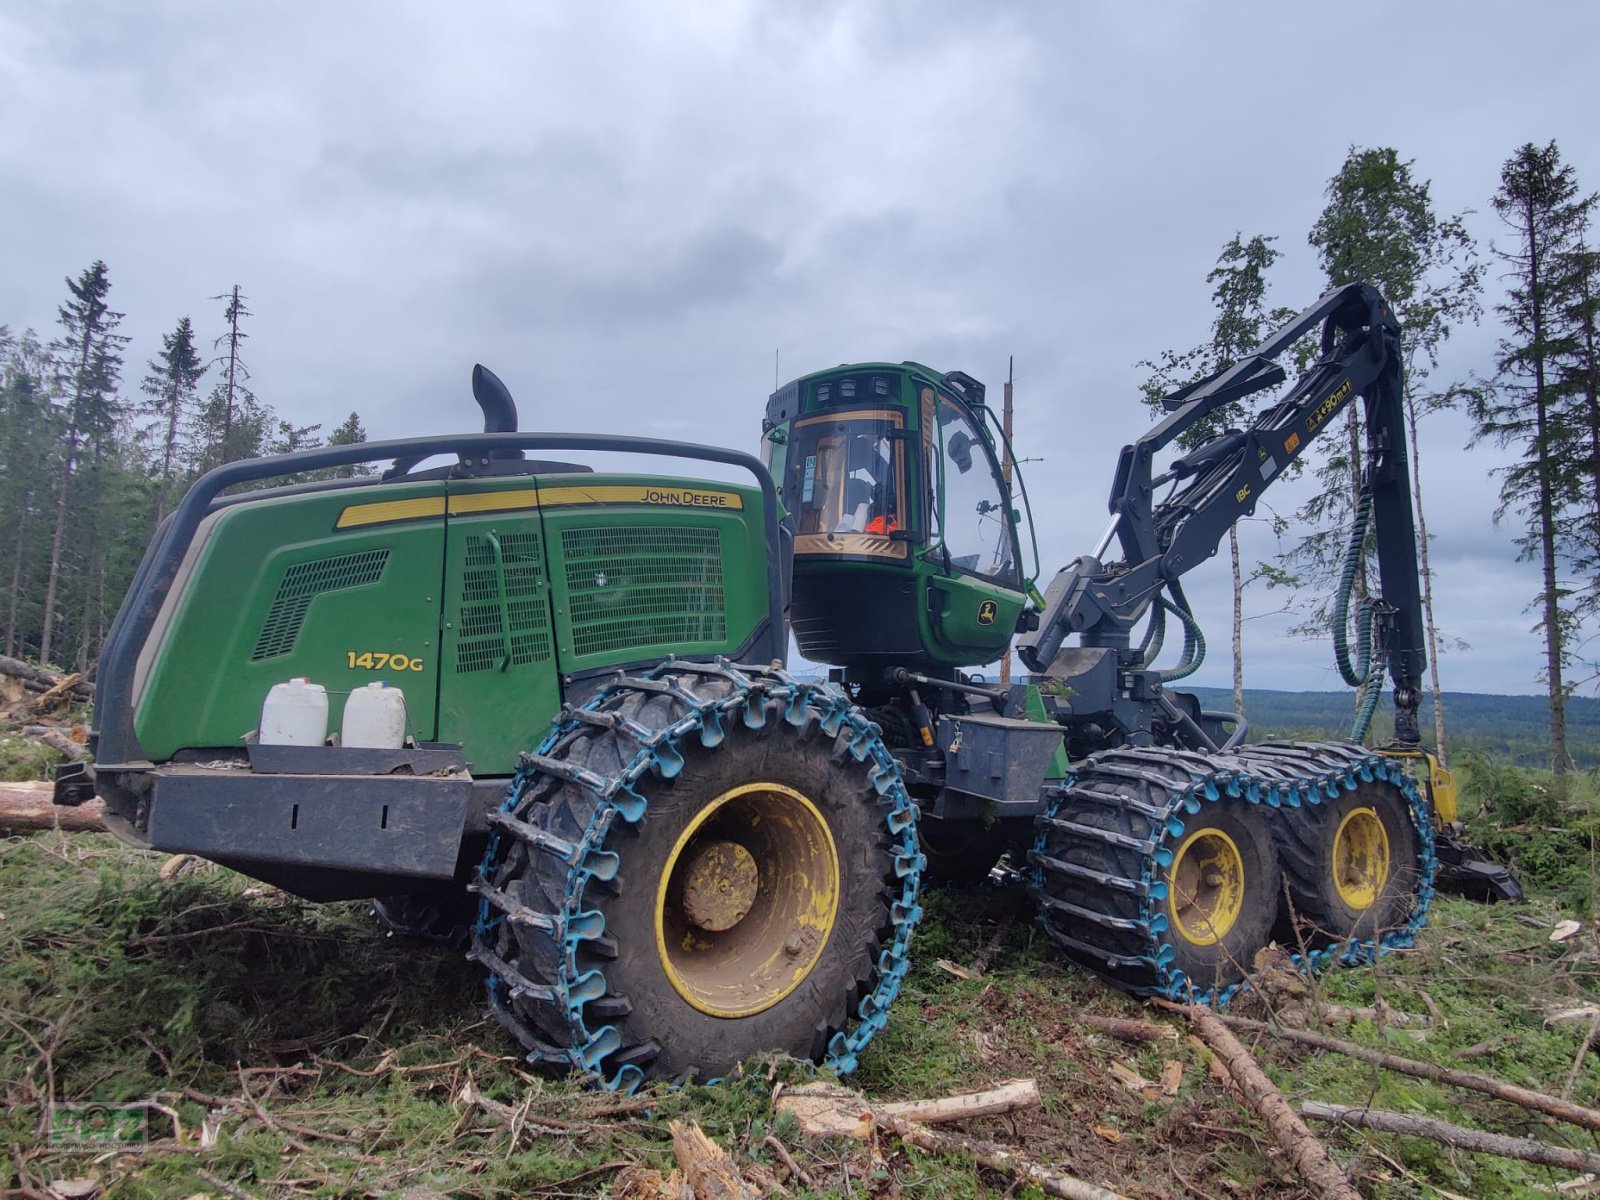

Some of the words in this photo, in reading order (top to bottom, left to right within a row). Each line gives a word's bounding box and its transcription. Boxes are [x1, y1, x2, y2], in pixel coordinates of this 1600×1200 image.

[641, 489, 680, 504] JOHN
[683, 491, 727, 506] DEERE
[1236, 482, 1251, 503] IBC
[347, 650, 424, 672] 1470G
